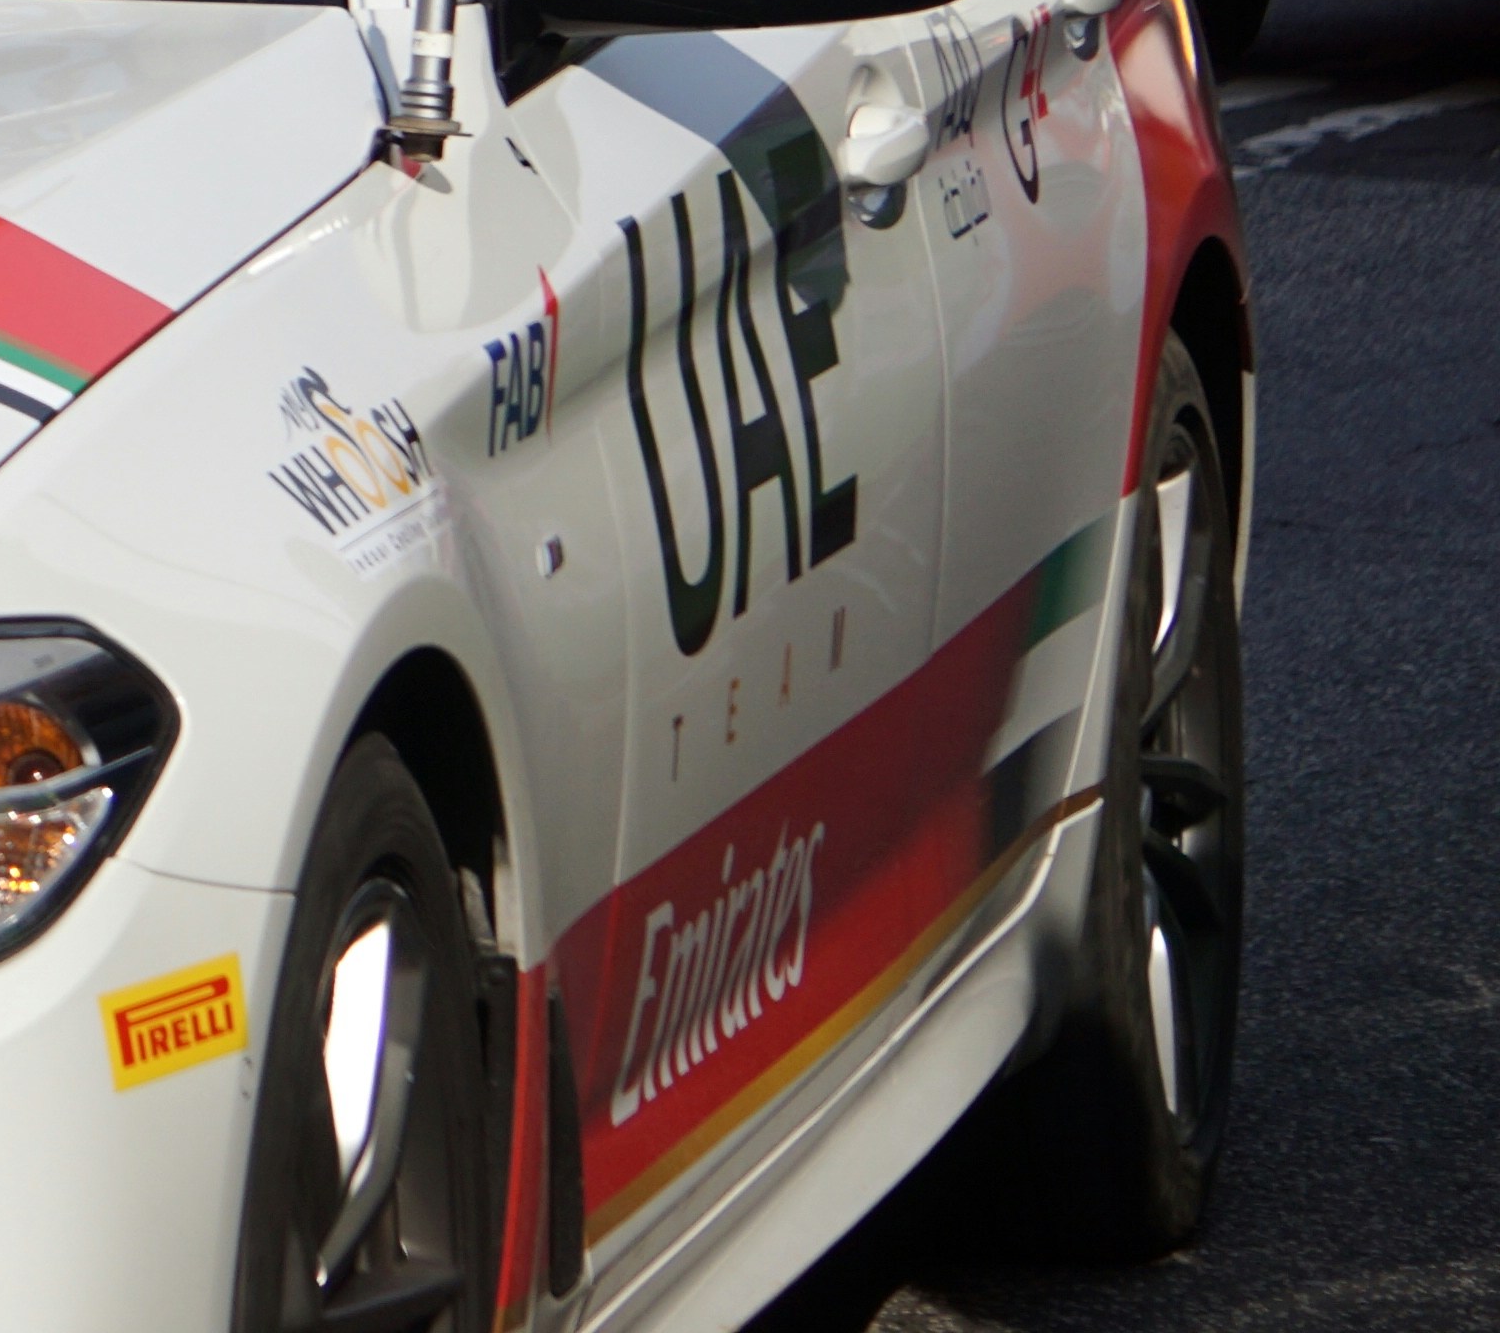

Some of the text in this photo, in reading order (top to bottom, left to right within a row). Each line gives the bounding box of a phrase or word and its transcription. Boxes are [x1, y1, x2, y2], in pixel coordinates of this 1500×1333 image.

[615, 135, 858, 657] UAE
[113, 972, 238, 1069] PIRELLI
[608, 817, 827, 1129] Emirates
